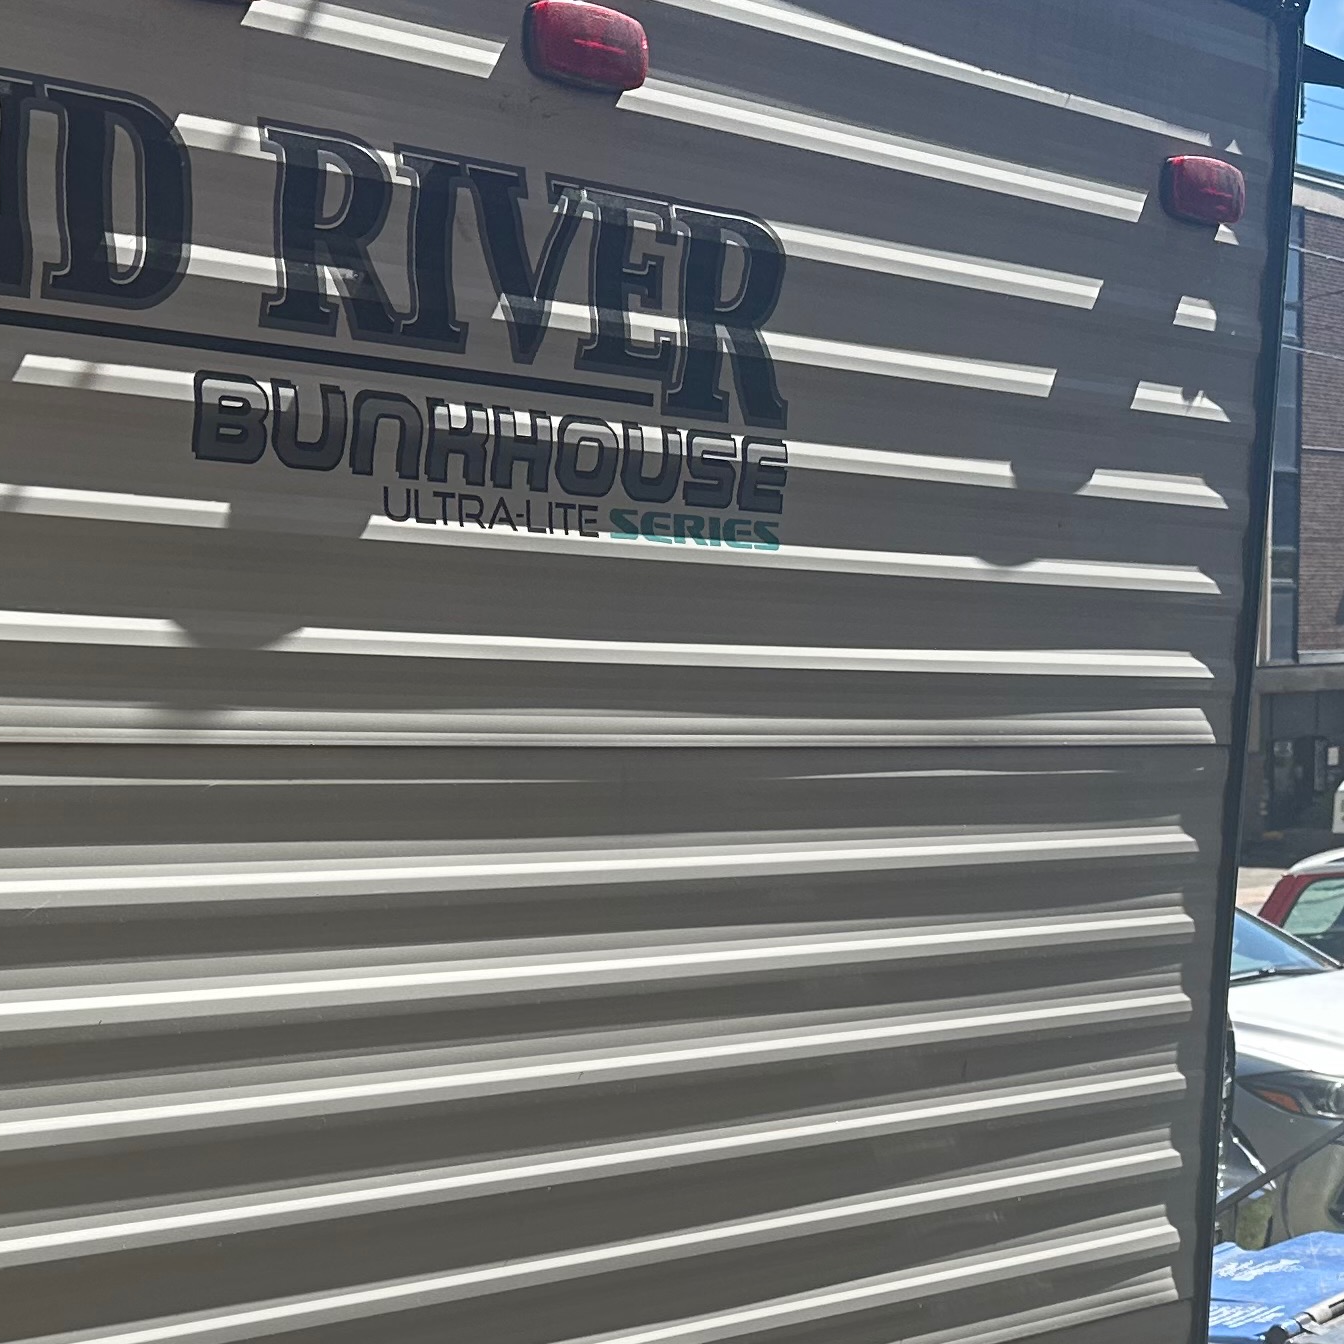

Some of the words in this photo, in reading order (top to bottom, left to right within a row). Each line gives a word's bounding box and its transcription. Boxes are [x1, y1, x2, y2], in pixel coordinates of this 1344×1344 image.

[257, 117, 788, 430] RIVER
[192, 369, 789, 515] BUNKHOUSE
[382, 486, 600, 539] ULTRA-LITE
[609, 506, 780, 552] SERIES
